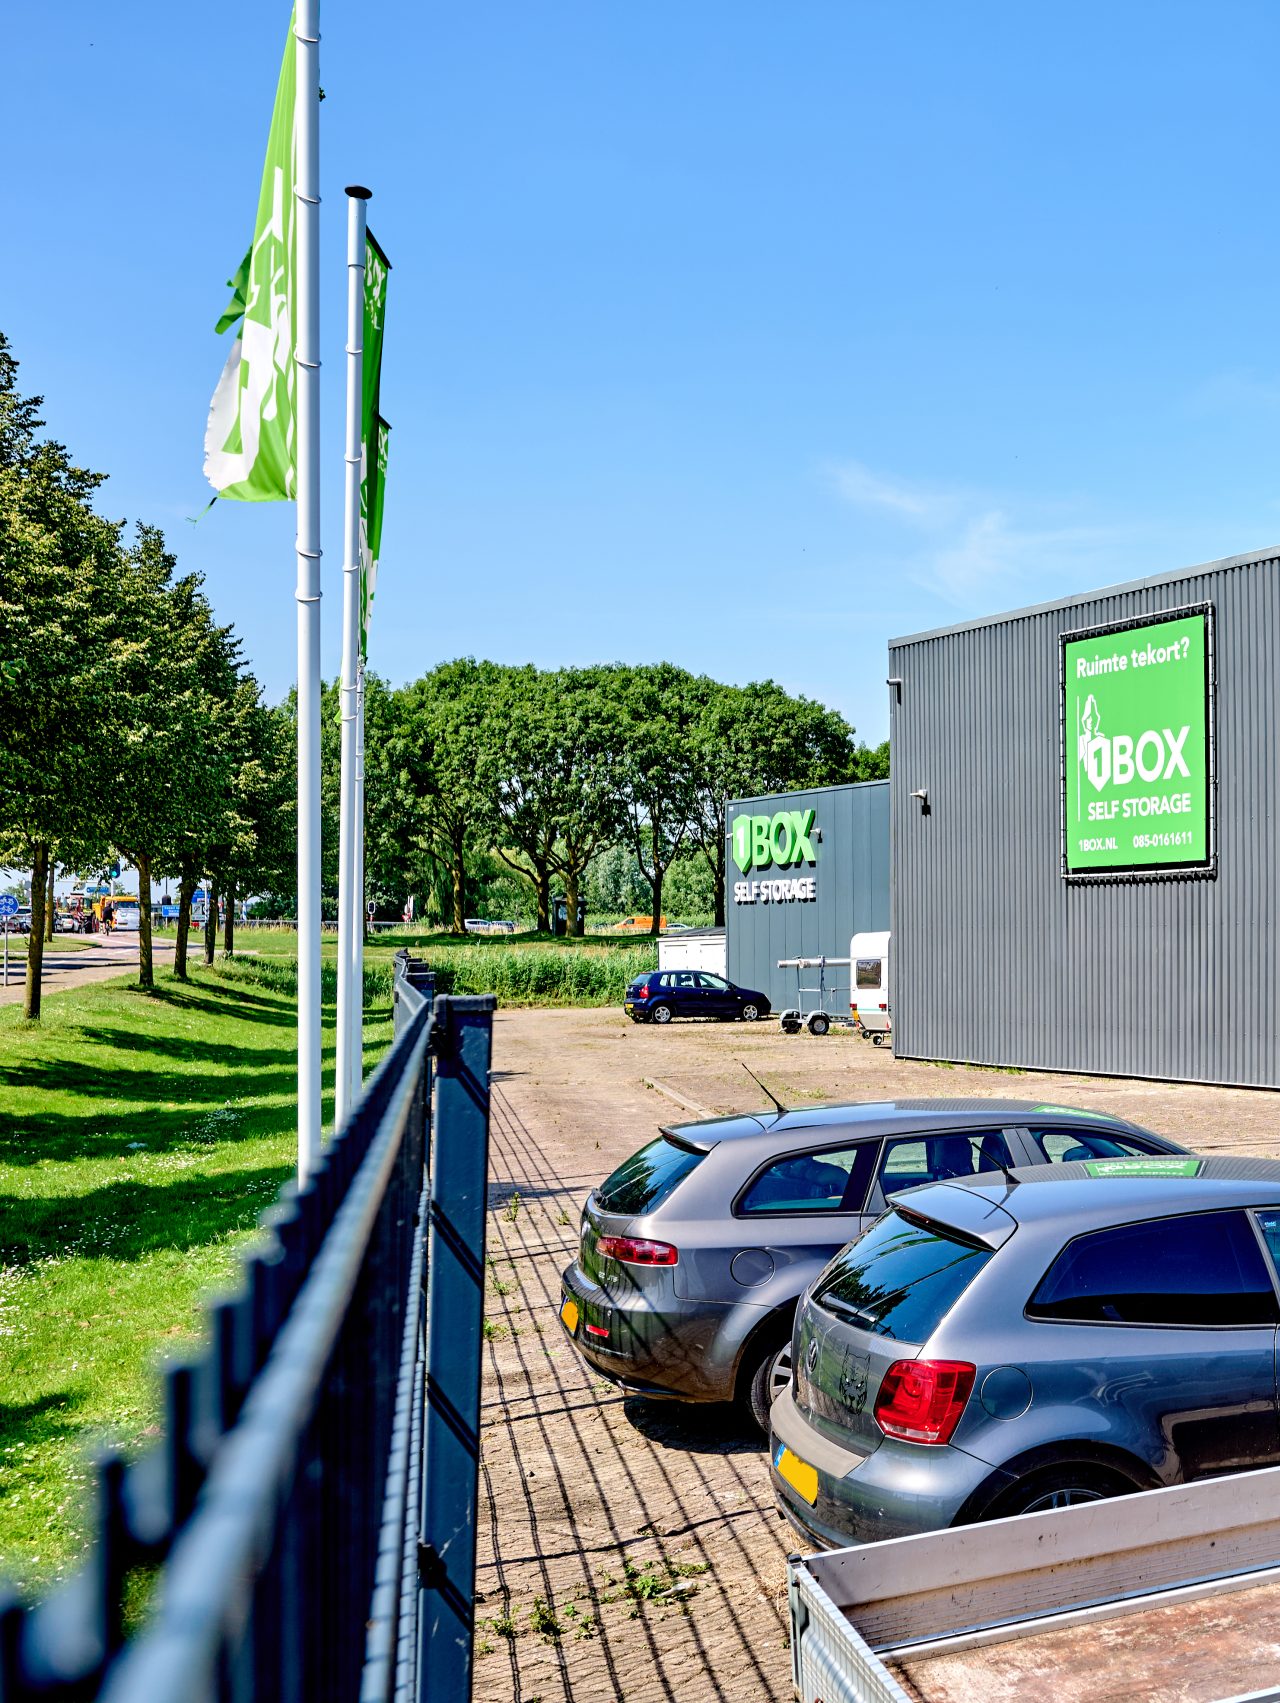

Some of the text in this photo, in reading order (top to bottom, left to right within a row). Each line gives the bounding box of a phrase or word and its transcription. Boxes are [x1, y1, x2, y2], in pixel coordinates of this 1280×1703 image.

[1076, 636, 1190, 679] Ruimte tekort?
[1087, 793, 1192, 821] SELF STORAGE
[1079, 831, 1193, 852] 1BOX.NL 085-0161611
[734, 877, 815, 902] SELF STORAGE
